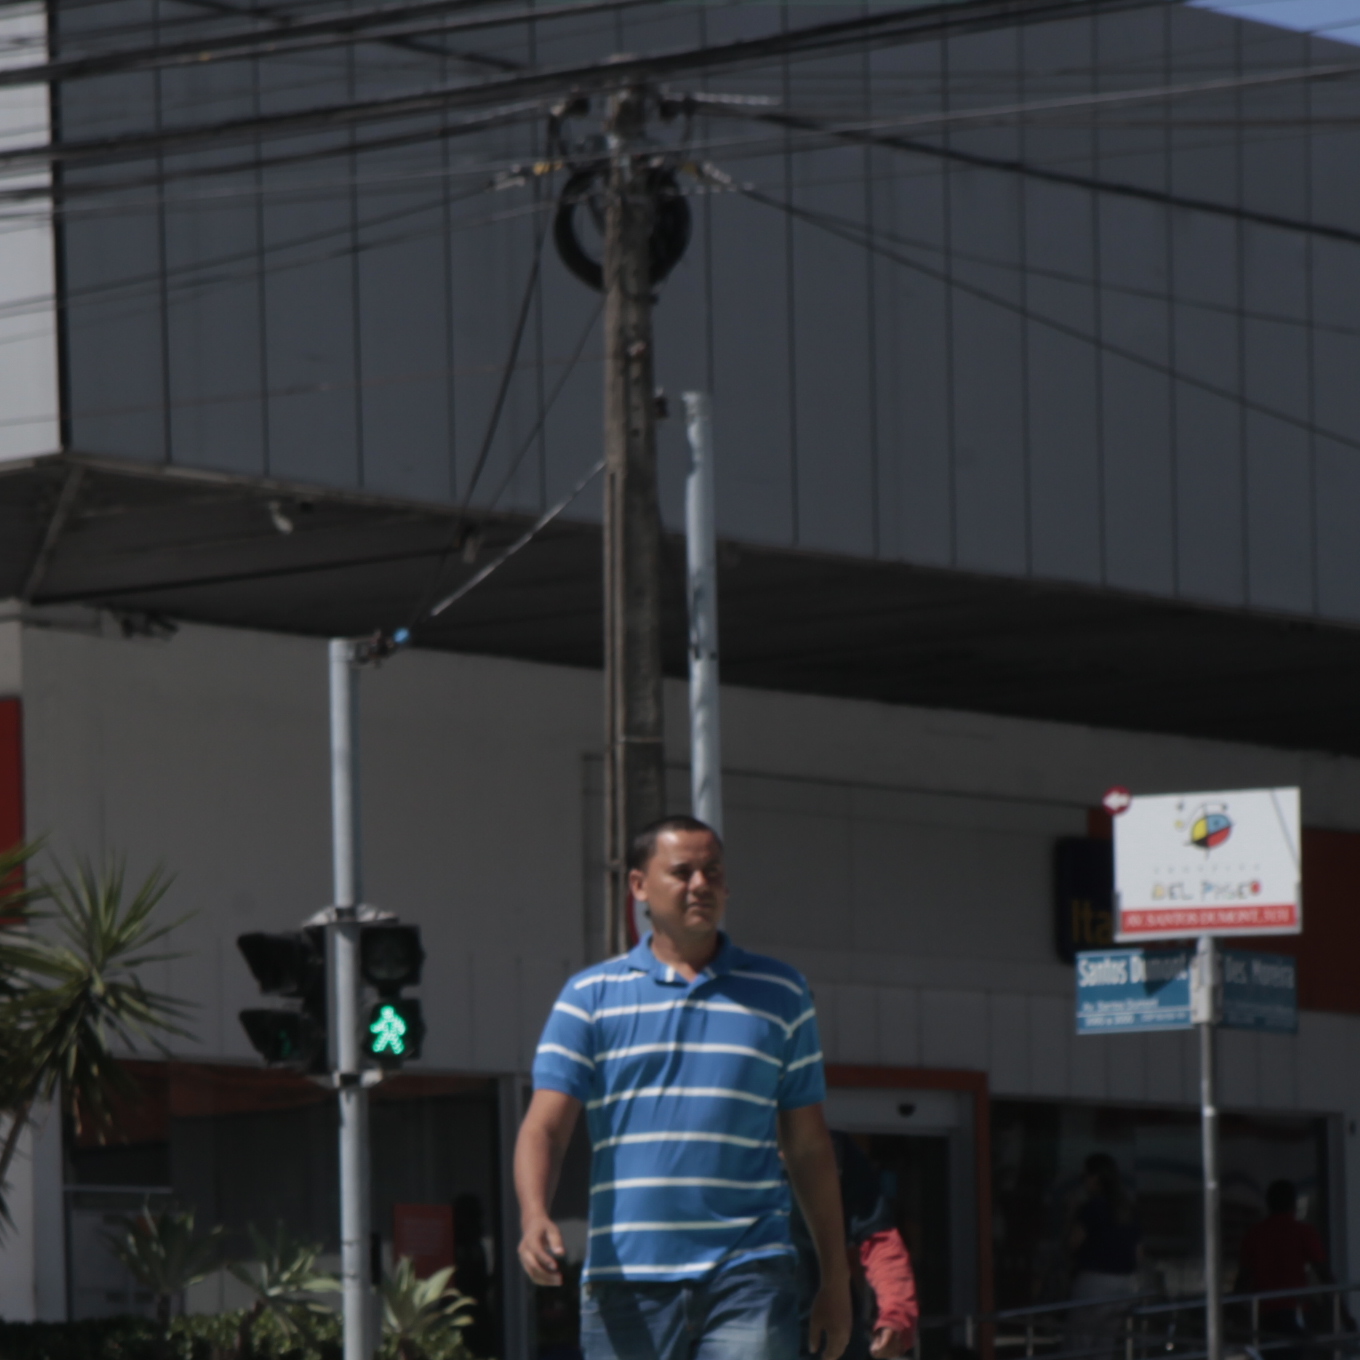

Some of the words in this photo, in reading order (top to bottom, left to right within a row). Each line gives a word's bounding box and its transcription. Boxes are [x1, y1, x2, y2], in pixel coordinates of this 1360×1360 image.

[1151, 881, 1194, 902] DEL
[1071, 896, 1114, 946] Ita
[1078, 957, 1128, 987] Santos
[1130, 953, 1188, 983] Dumont
